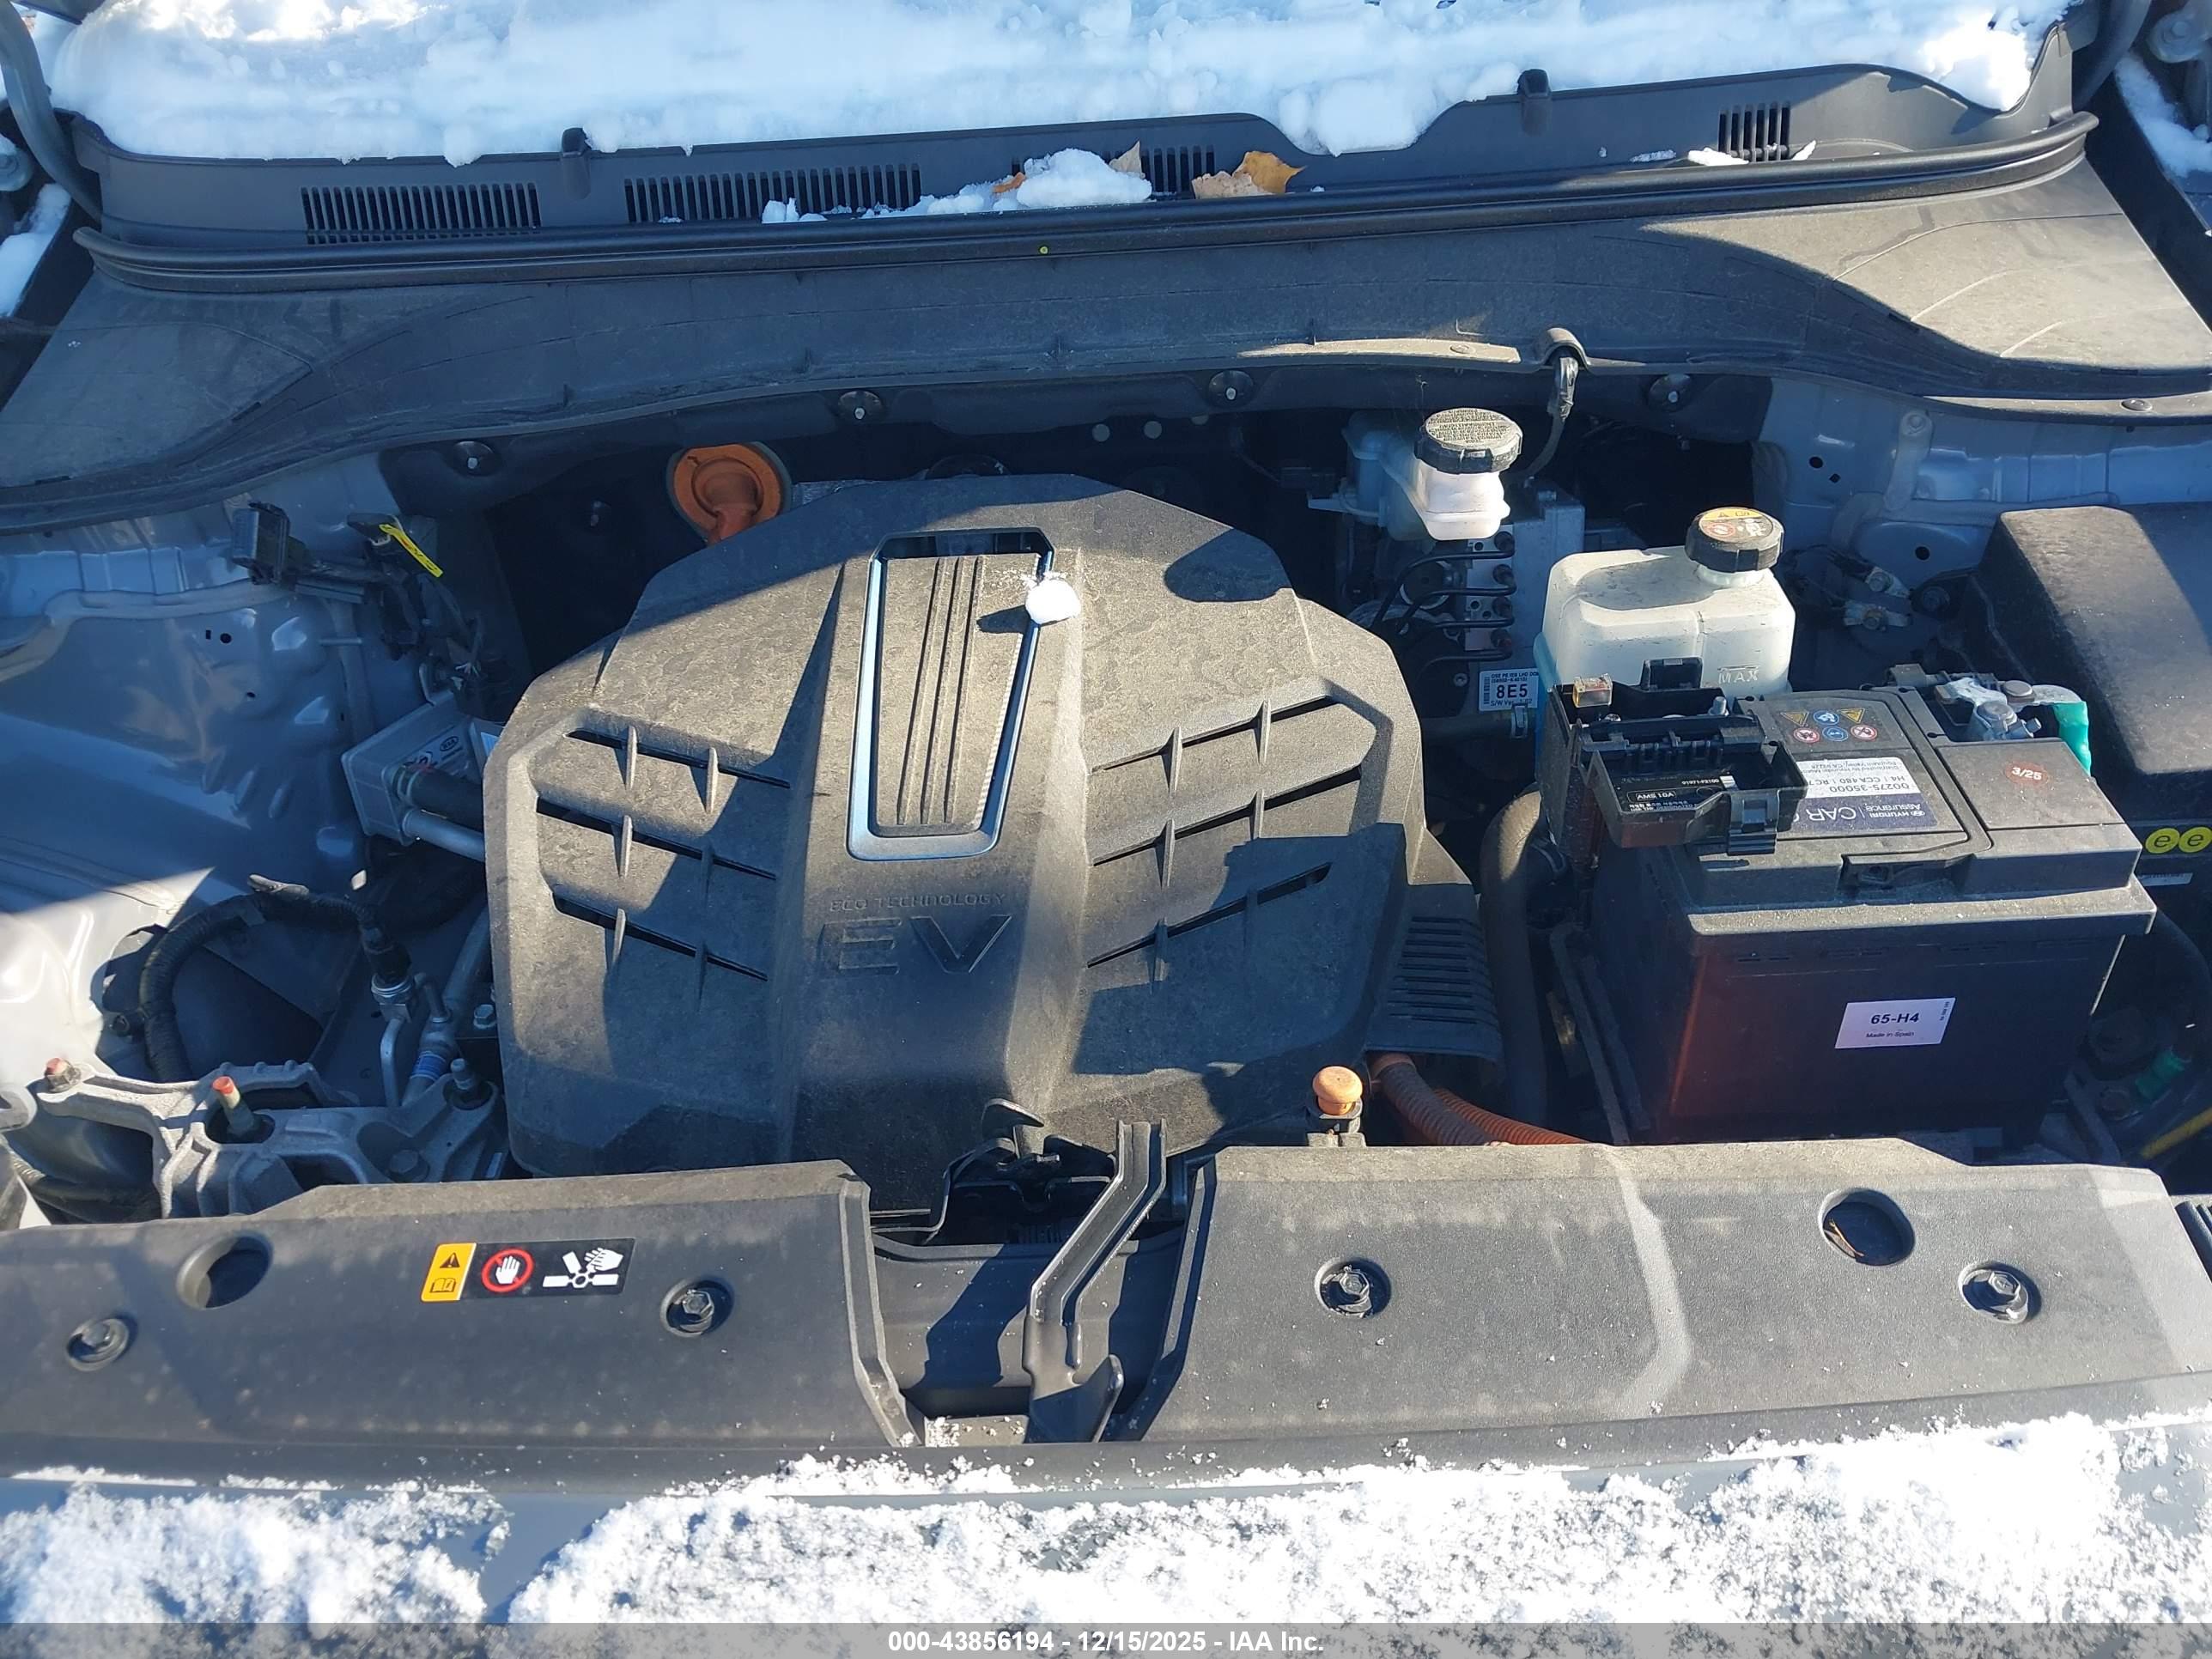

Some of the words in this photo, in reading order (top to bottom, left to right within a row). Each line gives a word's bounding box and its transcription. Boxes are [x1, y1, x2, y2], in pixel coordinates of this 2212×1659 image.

[1718, 671, 1759, 684] MAX
[1496, 684, 1528, 699] 8E5
[2011, 767, 2042, 781] 3/25
[1829, 782, 1910, 793] 00275-35000
[1806, 806, 1856, 822] CAR
[1868, 803, 1921, 811] Assurance
[830, 899, 868, 912] ECO
[874, 892, 1006, 908] TECHNOLOGY
[817, 914, 1013, 975] EV
[1870, 1012, 1920, 1024] 65-H4
